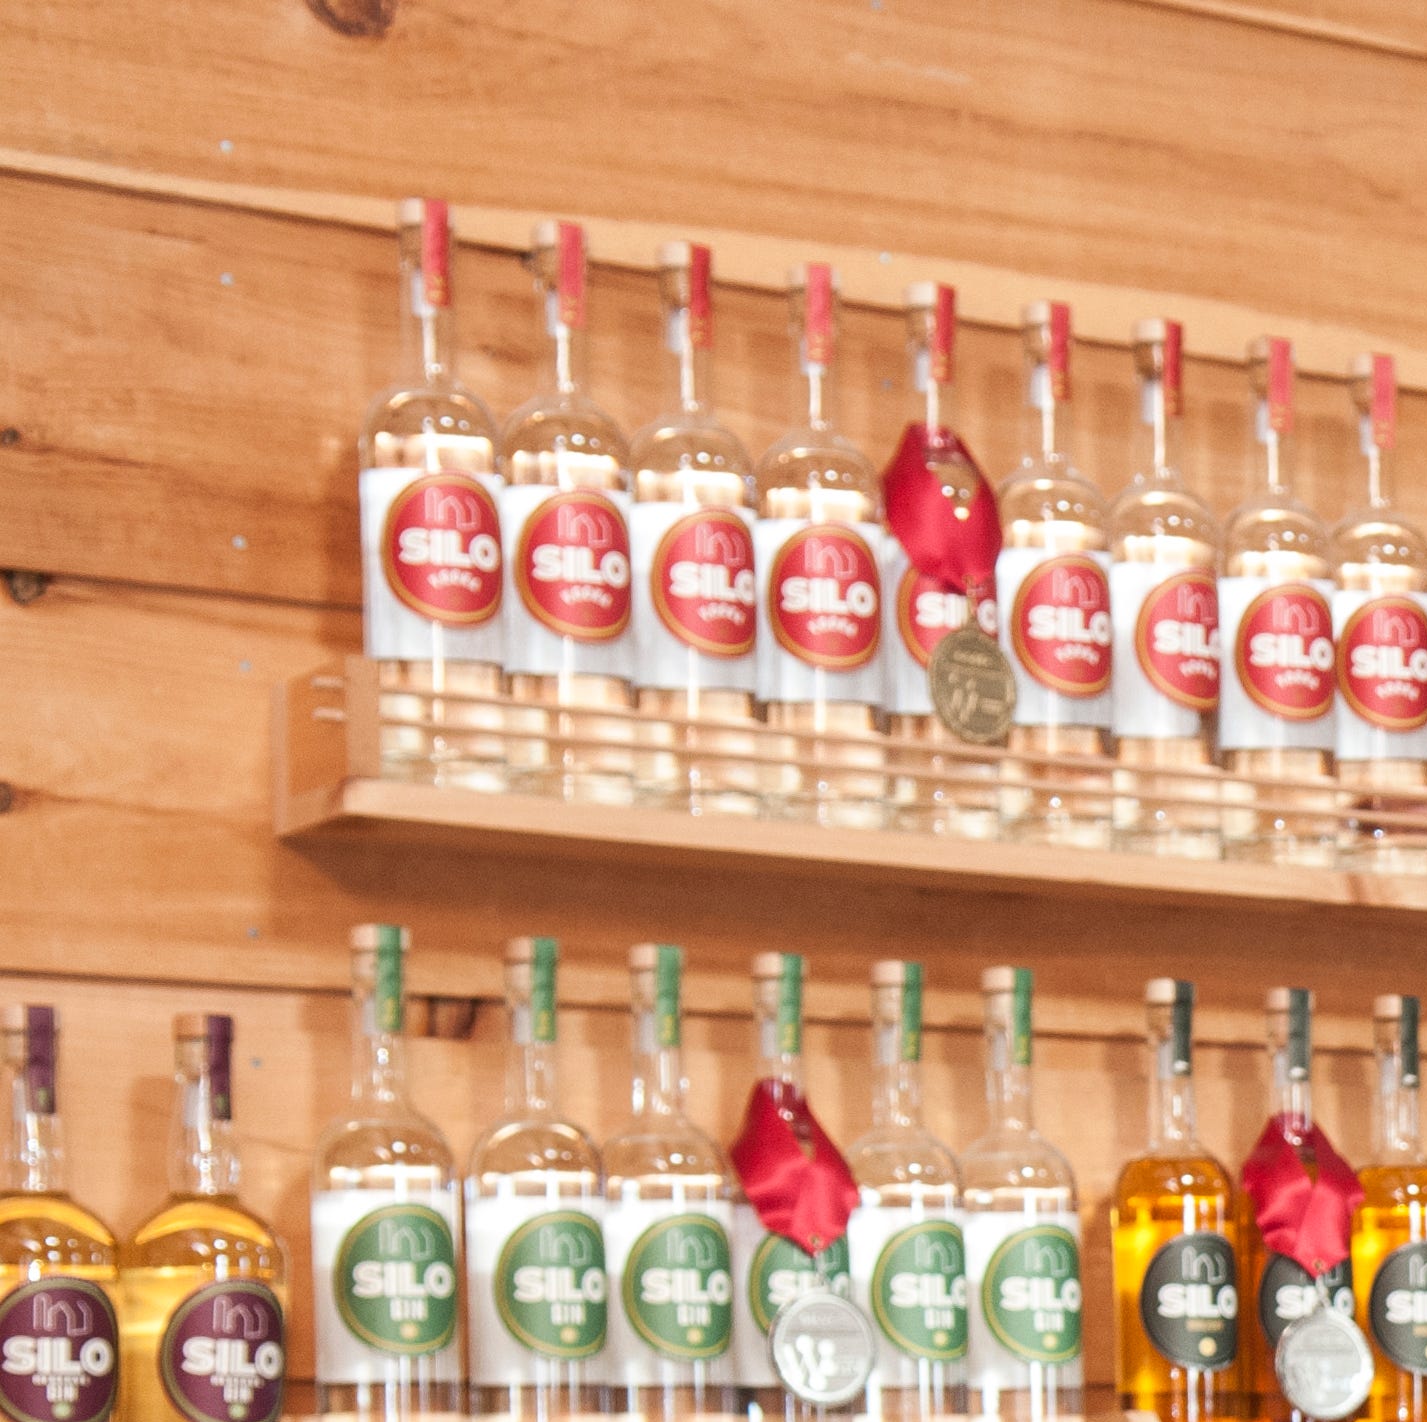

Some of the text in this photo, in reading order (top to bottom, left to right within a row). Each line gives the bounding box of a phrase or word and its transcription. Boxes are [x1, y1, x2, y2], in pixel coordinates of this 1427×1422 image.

[399, 527, 499, 570] SILO
[532, 544, 629, 586] SILO
[780, 576, 878, 617] SILO
[1249, 633, 1335, 671] SILO
[352, 1260, 456, 1298] SILO
[513, 1266, 607, 1302] SILO
[640, 1267, 732, 1304] SILO
[999, 1276, 1081, 1310] SILO
[1156, 1282, 1237, 1319] SILO
[1, 1335, 114, 1377] SILO
[181, 1335, 285, 1378] SILO
